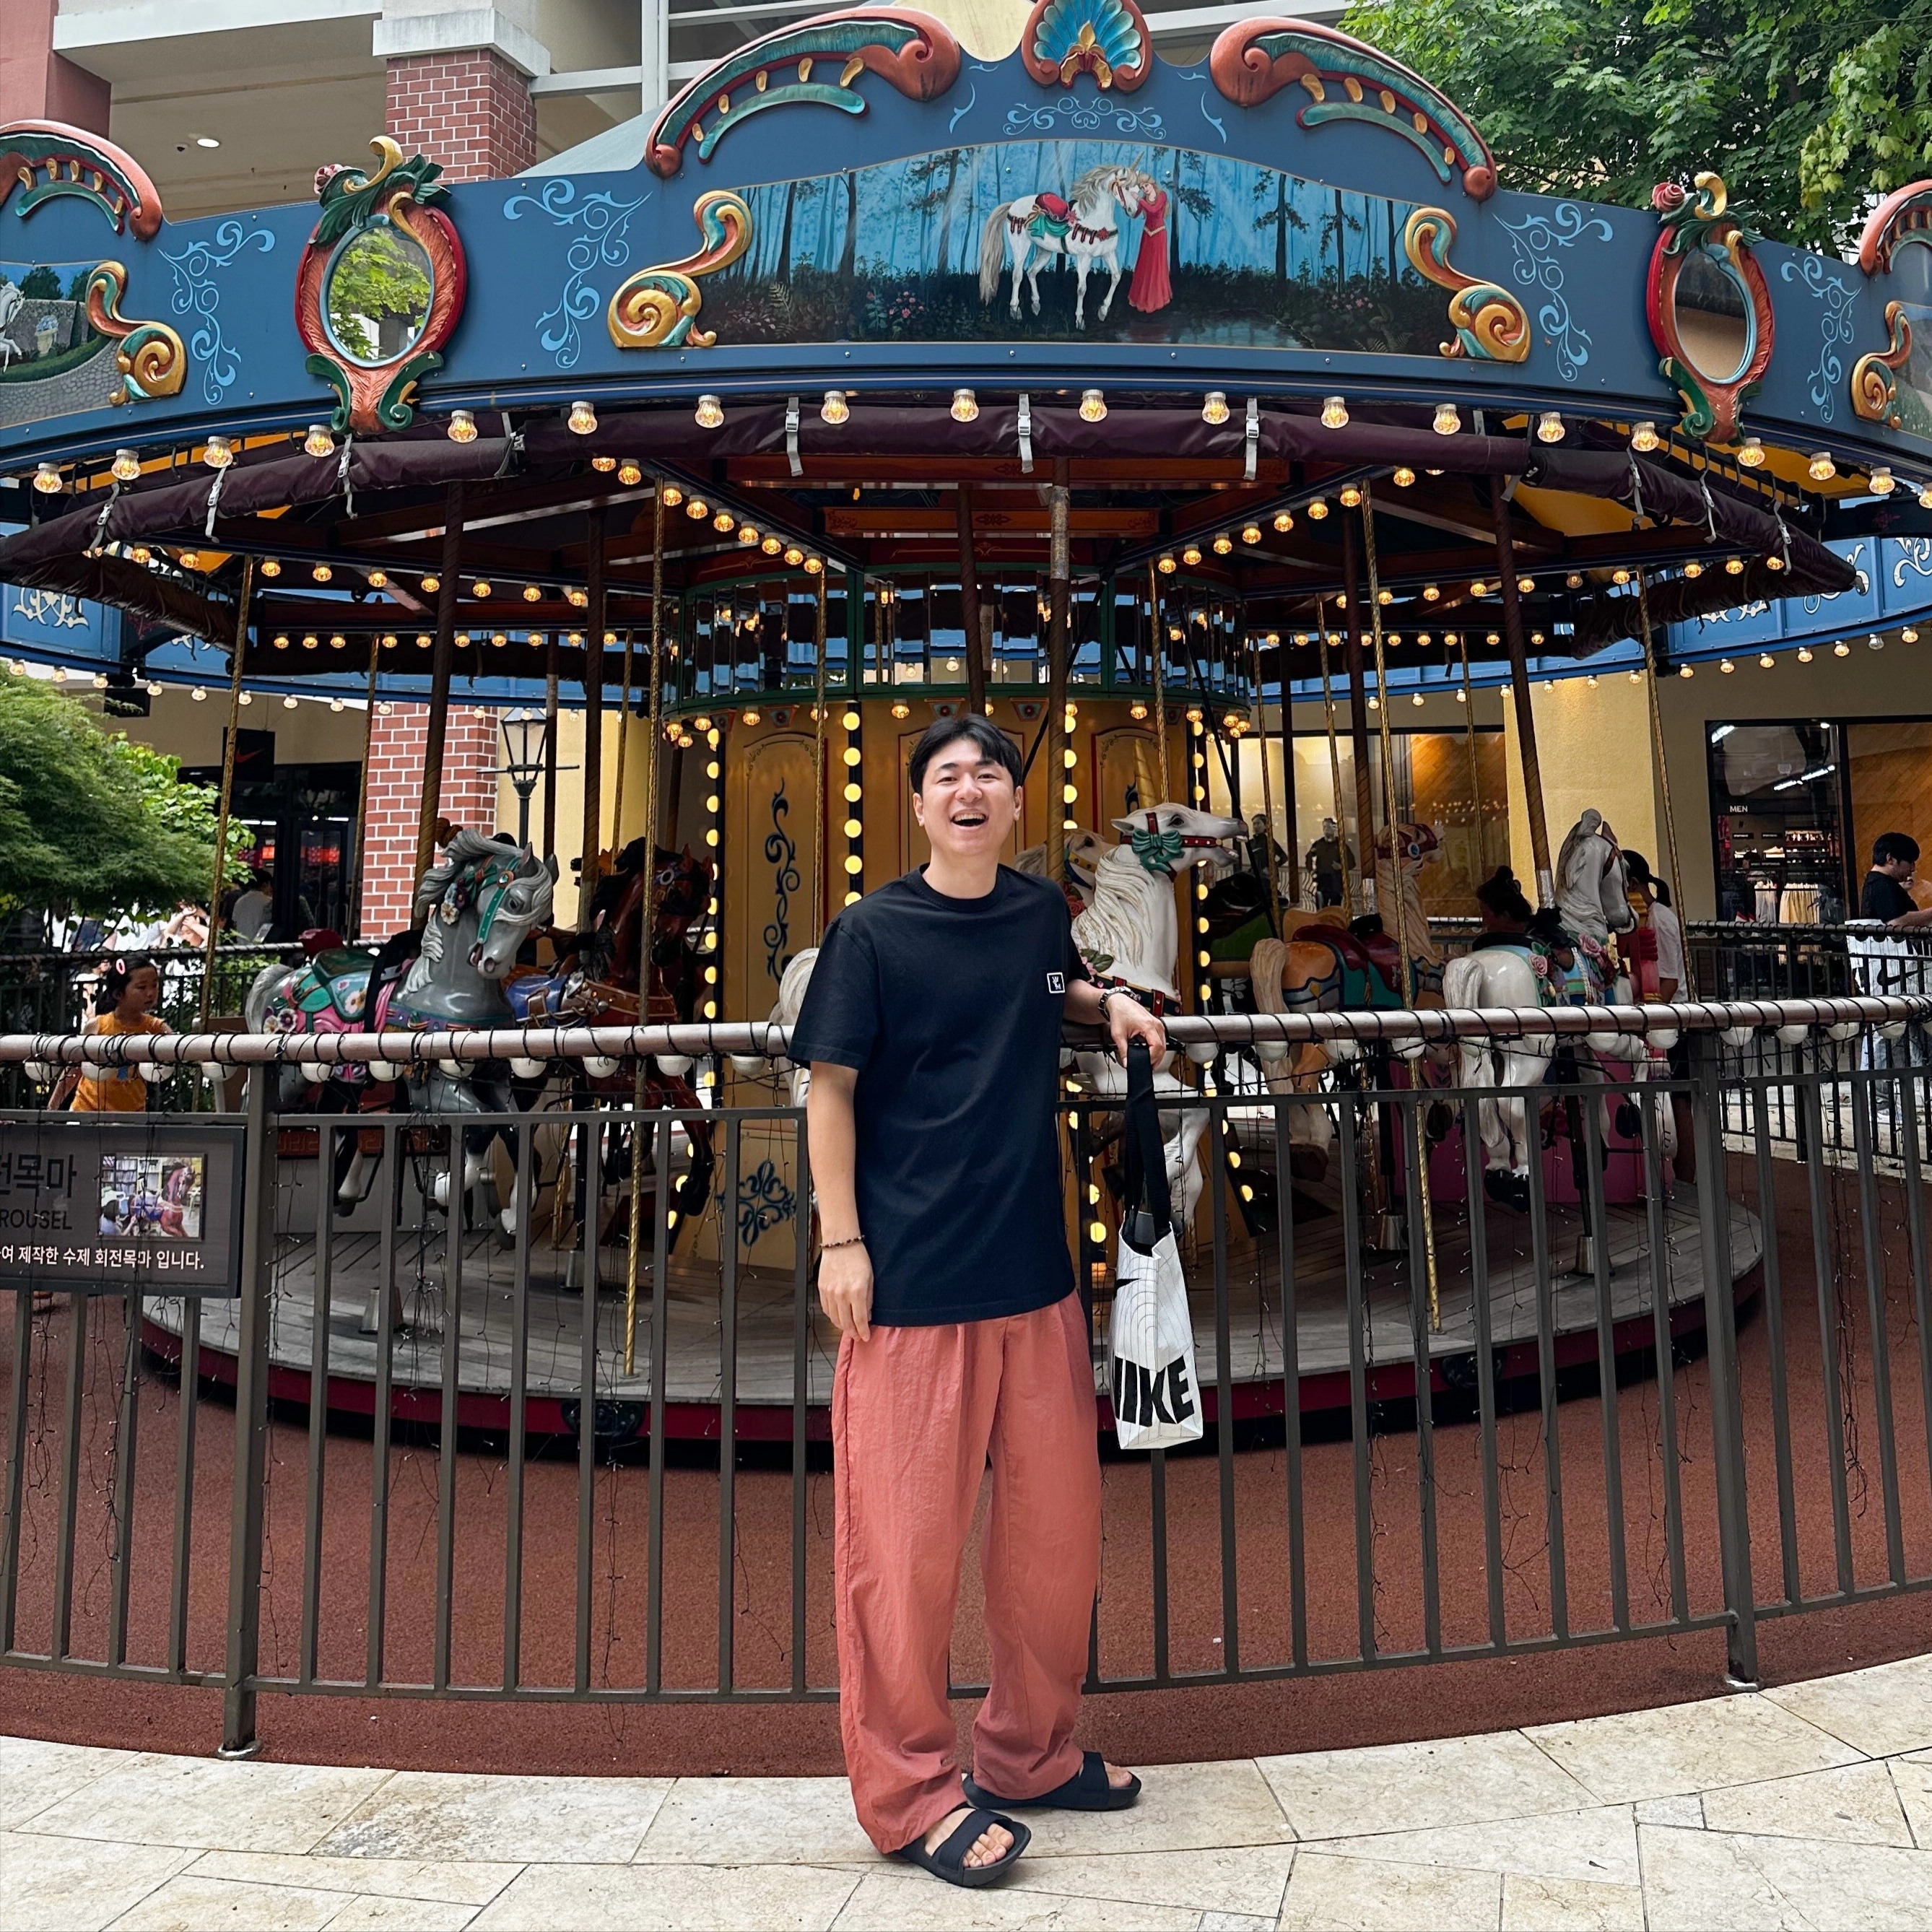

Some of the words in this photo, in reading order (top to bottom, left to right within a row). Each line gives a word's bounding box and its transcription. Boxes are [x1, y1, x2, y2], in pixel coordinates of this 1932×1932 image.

[0, 1244, 14, 1263] 여
[18, 1245, 58, 1265] 제작한
[62, 1248, 90, 1266] 수제
[95, 1248, 151, 1269] 회전목마
[156, 1250, 204, 1269] 입니다.
